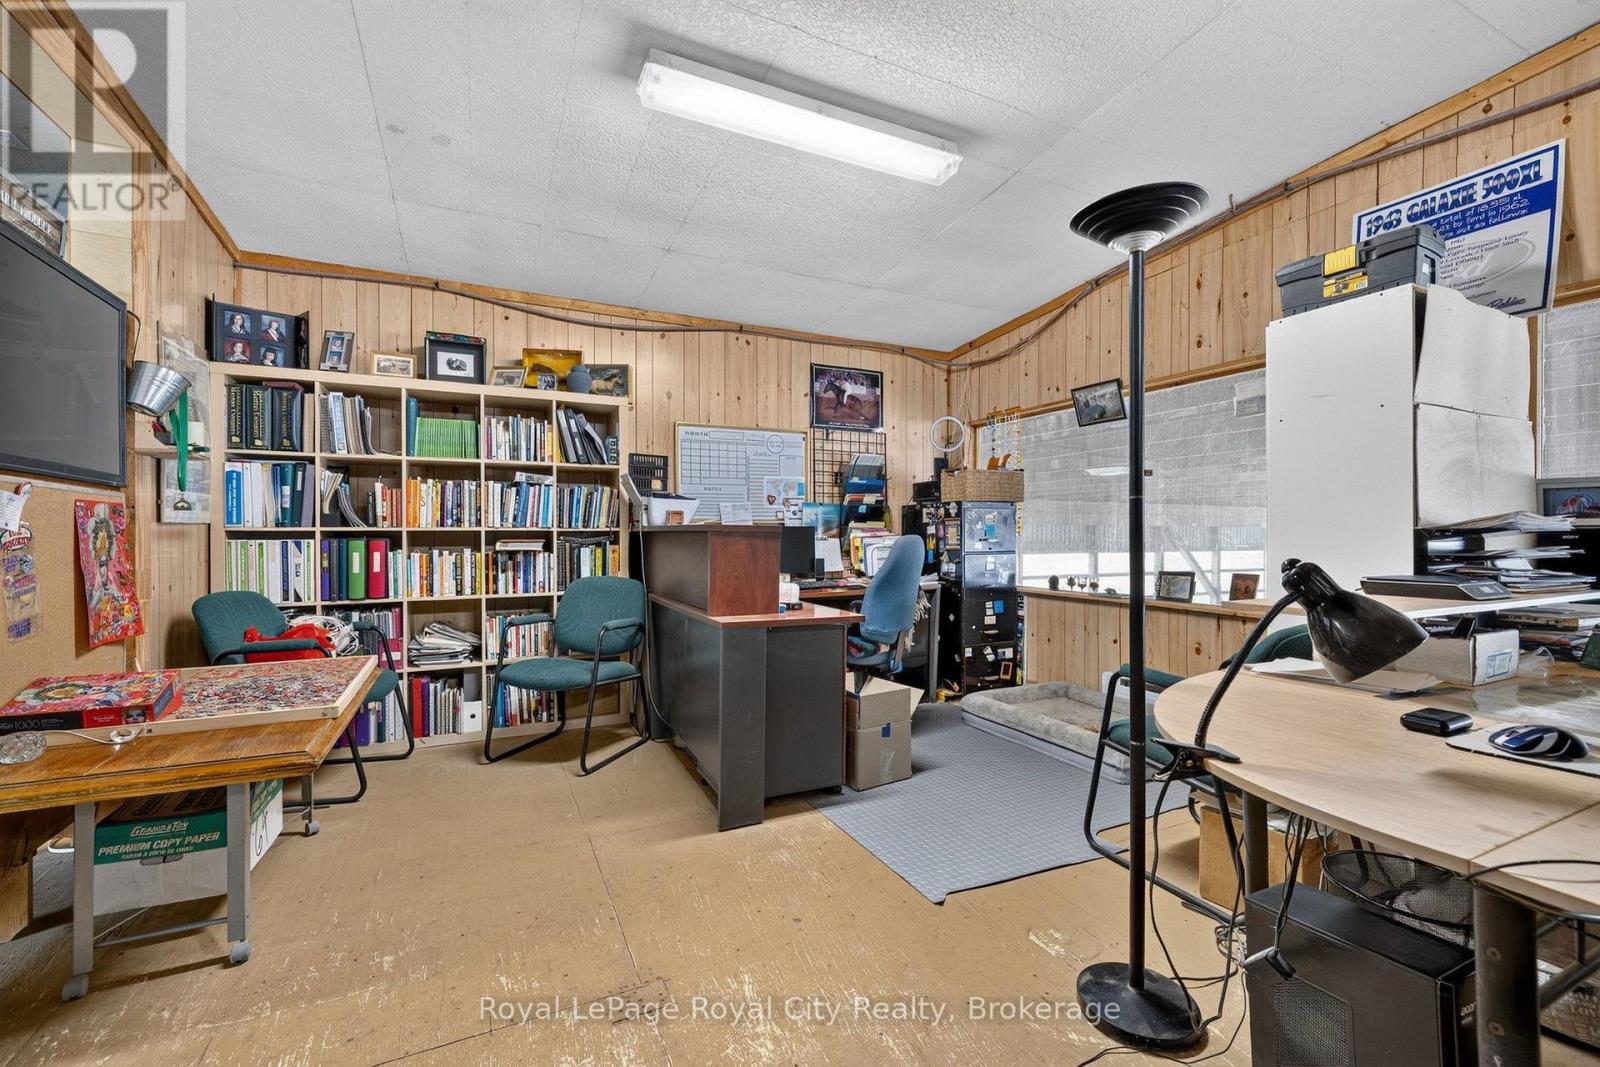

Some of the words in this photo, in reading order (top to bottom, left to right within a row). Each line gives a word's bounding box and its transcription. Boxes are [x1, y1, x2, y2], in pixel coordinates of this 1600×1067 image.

[1366, 208, 1402, 238] 1963
[1406, 180, 1478, 223] GALAXIE
[1481, 159, 1543, 200] 500XL
[14, 720, 40, 730] 1000
[98, 841, 150, 857] PREMIUM
[153, 837, 184, 850] COPY
[184, 831, 220, 845] PAPER
